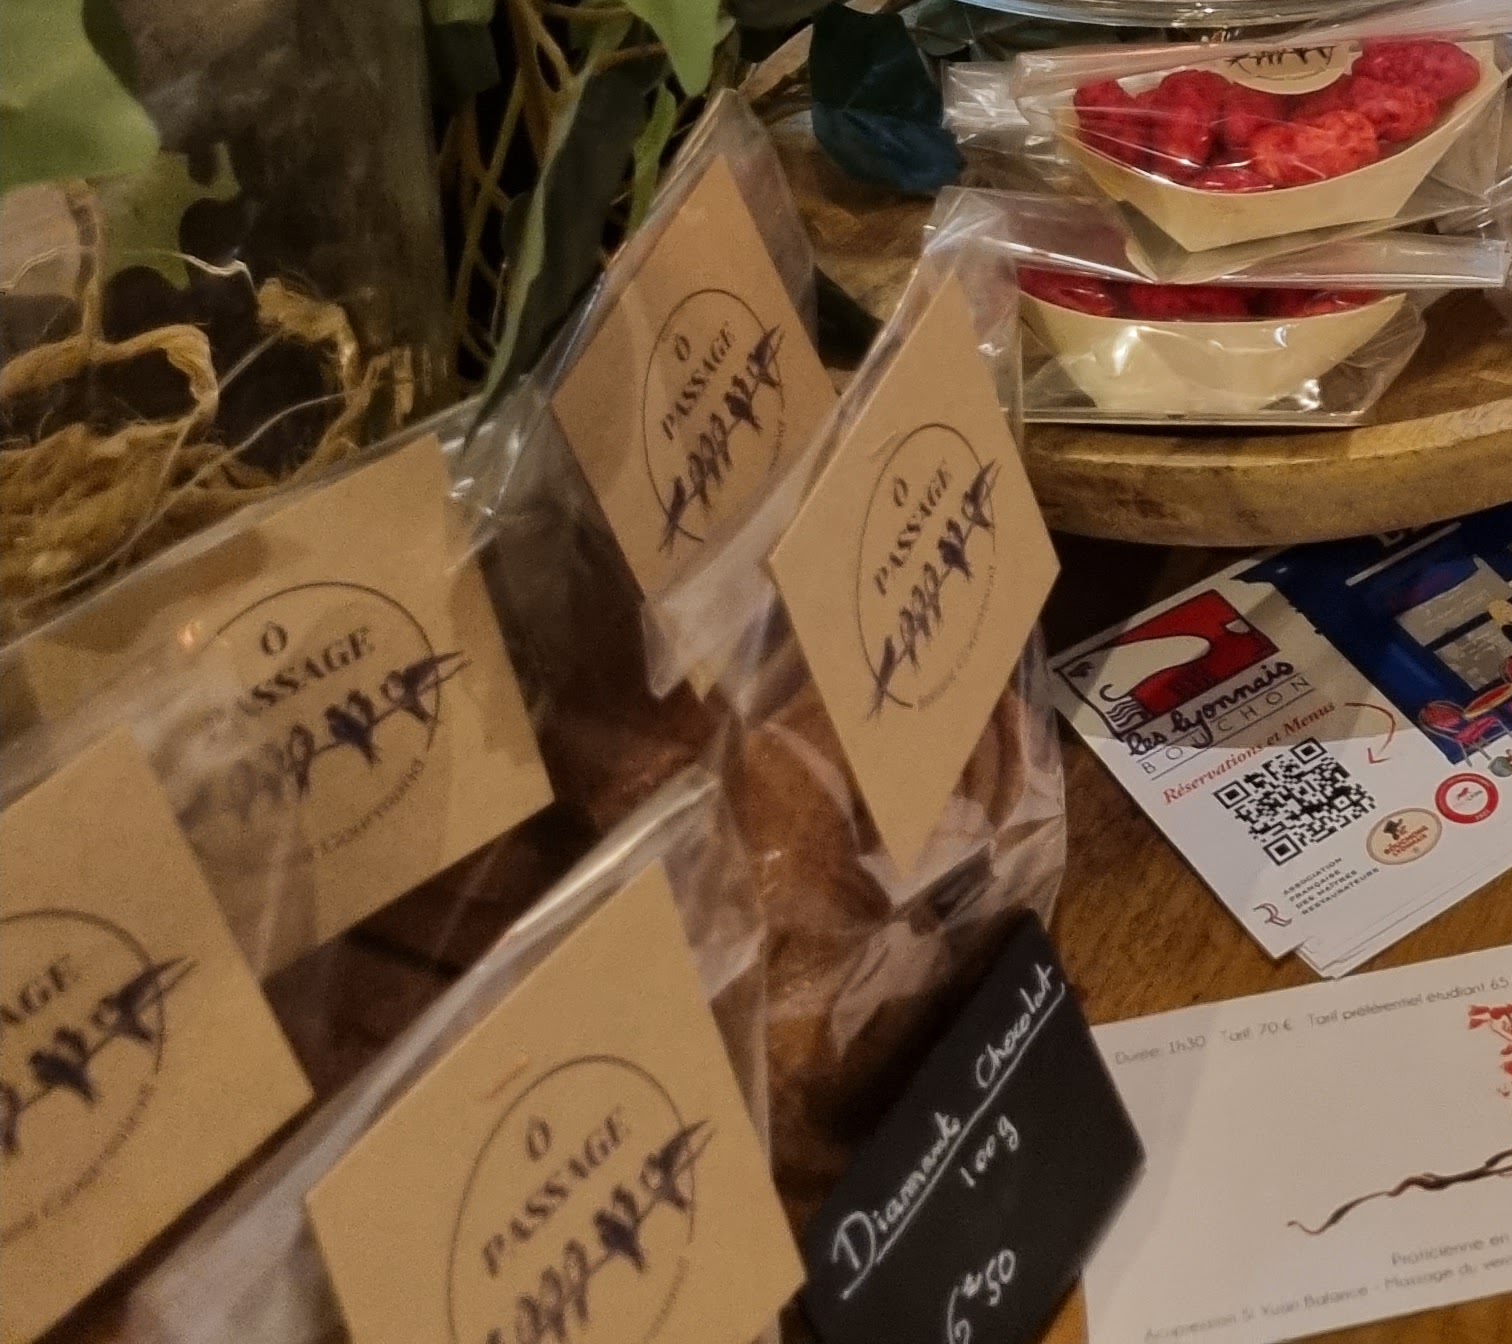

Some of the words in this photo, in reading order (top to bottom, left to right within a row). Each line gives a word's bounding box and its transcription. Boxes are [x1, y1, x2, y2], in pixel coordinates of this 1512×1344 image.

[660, 318, 737, 443] PASSAGE
[873, 457, 953, 598] PASSAGE
[1140, 676, 1310, 775] BOUCHON
[1170, 661, 1295, 750] lyonnais
[1162, 743, 1263, 806] Réservations
[1266, 730, 1281, 747] et
[1284, 701, 1336, 737] Menus
[1282, 856, 1343, 897] ASSOCIATION
[1300, 866, 1381, 916] RESTAURATEURS
[1168, 1033, 1208, 1057] 1h30
[1219, 1026, 1253, 1045] Tarif
[1258, 1020, 1281, 1036] 70
[1306, 1010, 1340, 1031] Tarif
[1341, 990, 1425, 1025] préférentiel
[1426, 982, 1487, 1005] étudiant
[1489, 976, 1511, 993] 65
[480, 1105, 628, 1279] PASSAGE
[1384, 1264, 1455, 1291] Massage
[1489, 1230, 1510, 1246] en
